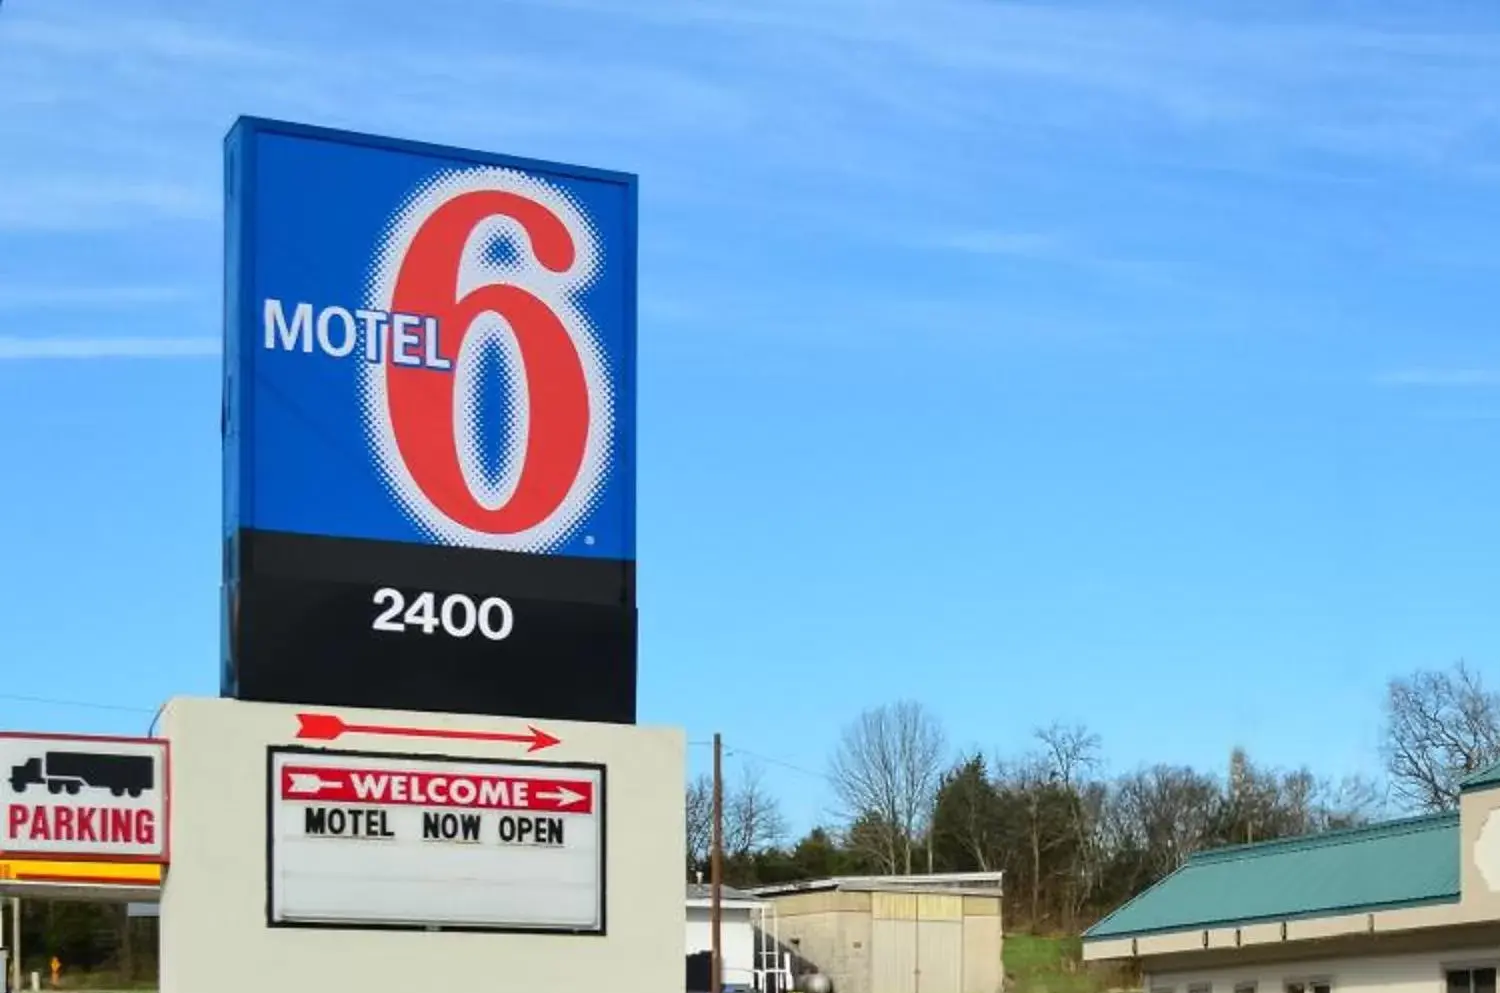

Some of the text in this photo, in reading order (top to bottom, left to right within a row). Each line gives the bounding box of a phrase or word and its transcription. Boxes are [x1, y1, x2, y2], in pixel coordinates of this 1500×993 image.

[264, 189, 590, 535] MOTEL 6
[373, 587, 514, 641] 2400
[349, 772, 530, 808] WELCOME
[8, 803, 155, 845] PARKING
[304, 806, 565, 845] MOTEL NOW OPEN
